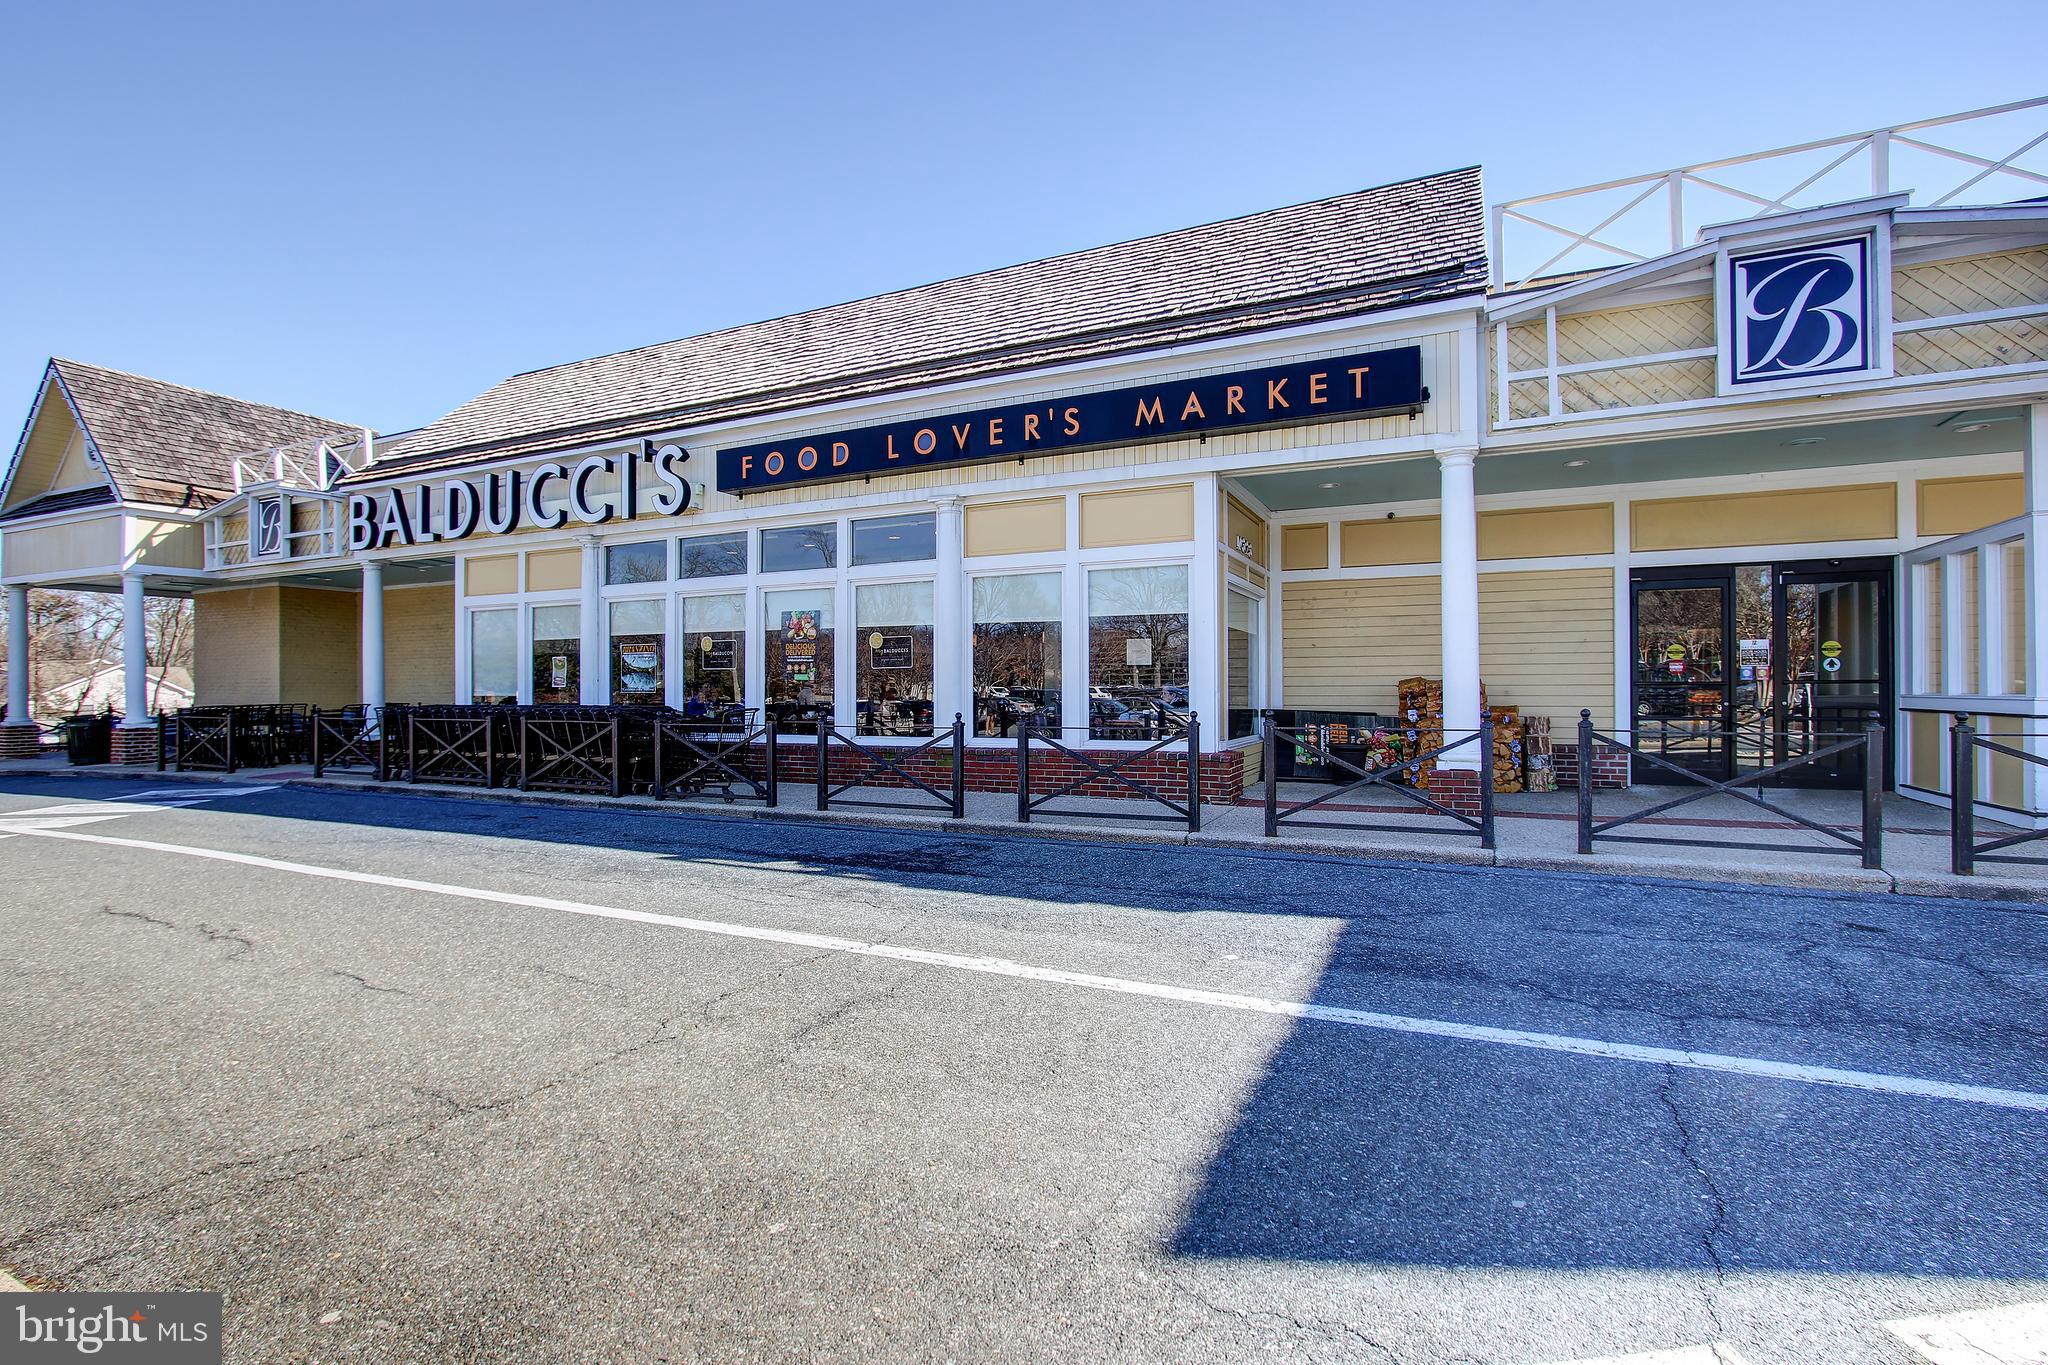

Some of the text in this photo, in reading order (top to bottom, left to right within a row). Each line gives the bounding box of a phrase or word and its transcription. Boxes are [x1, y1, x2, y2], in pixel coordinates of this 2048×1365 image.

[741, 367, 1370, 479] FOOD LOVER'S MARKET
[348, 438, 691, 551] BALDUCCI'S
